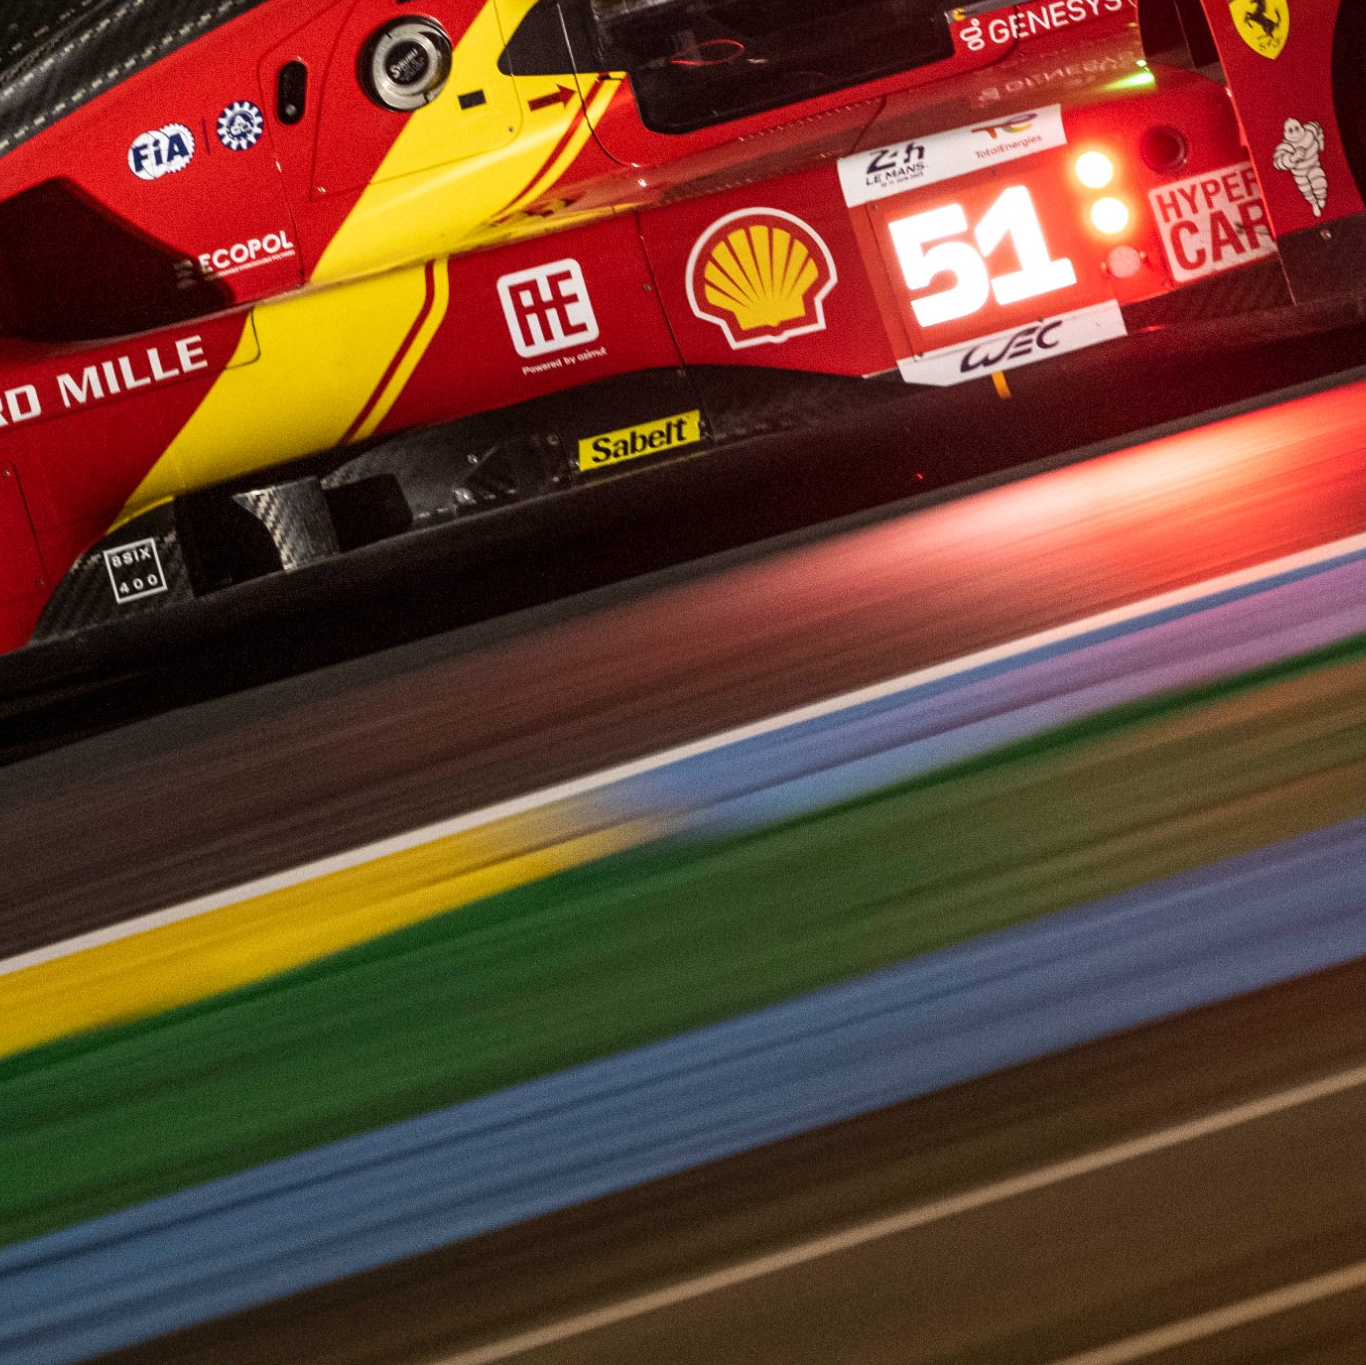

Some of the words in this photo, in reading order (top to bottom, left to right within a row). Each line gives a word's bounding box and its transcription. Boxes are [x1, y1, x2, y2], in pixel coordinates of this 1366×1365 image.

[198, 230, 294, 274] ECOPOL
[887, 184, 1077, 328] 51
[521, 358, 563, 376] Powered
[960, 320, 1062, 373] WEC
[55, 334, 208, 409] MILLE
[591, 418, 687, 463] Sabelt
[119, 574, 158, 594] 400
